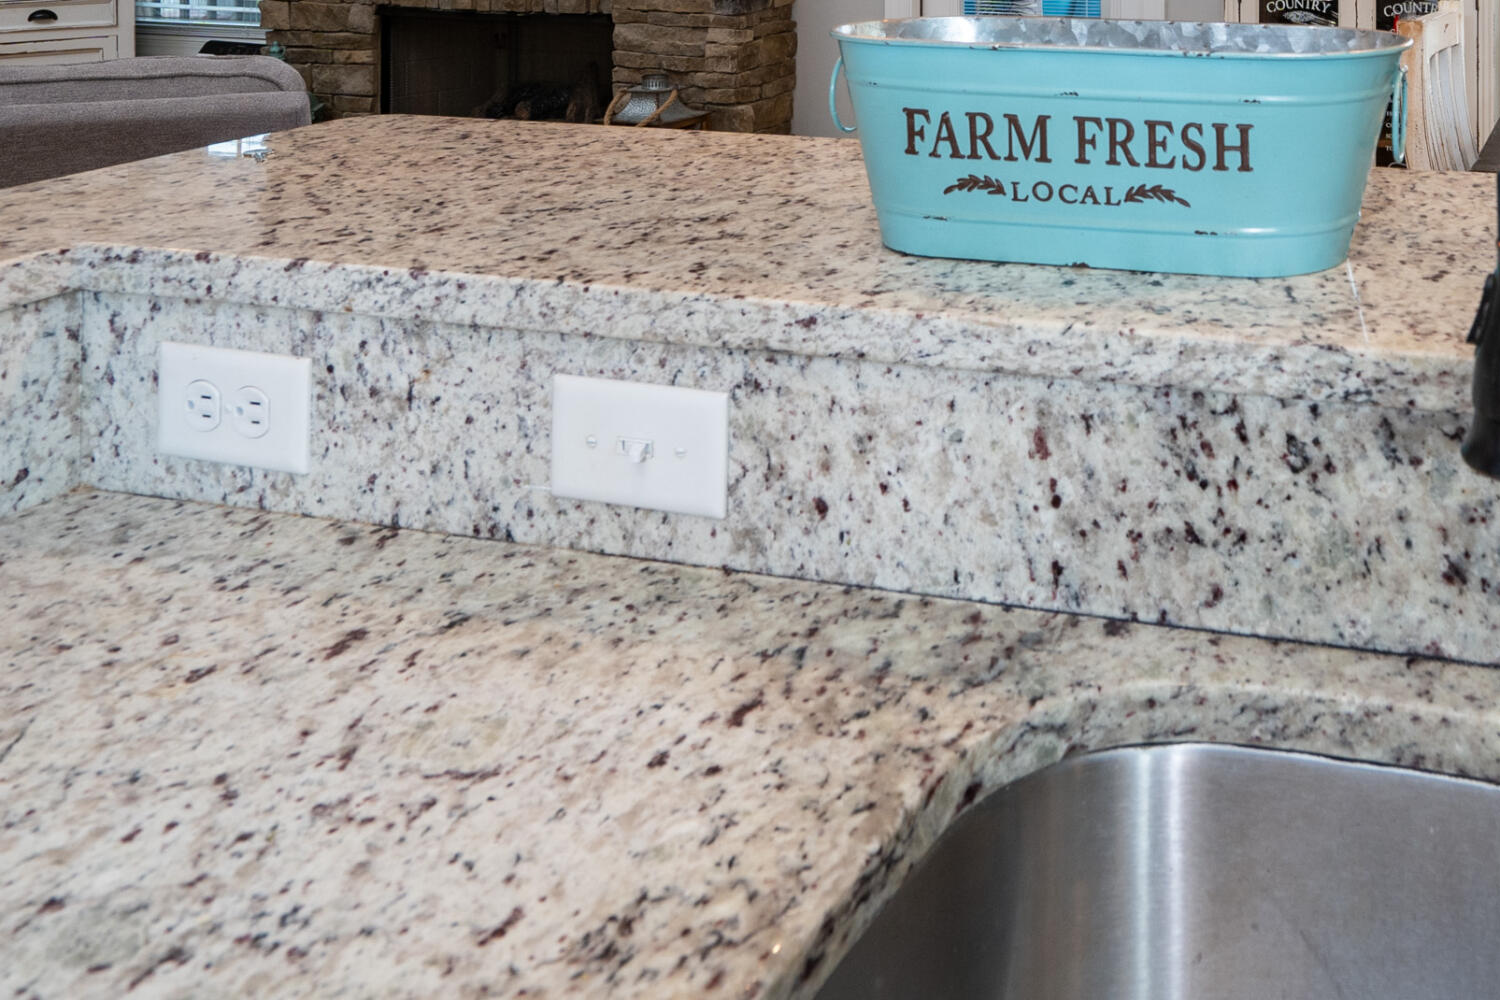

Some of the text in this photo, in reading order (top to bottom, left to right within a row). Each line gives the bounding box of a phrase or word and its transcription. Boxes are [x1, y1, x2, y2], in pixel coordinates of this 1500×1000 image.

[1383, 1, 1438, 17] COUNTR
[902, 107, 1255, 174] FARM FRESH
[1011, 180, 1122, 207] LOCAL
